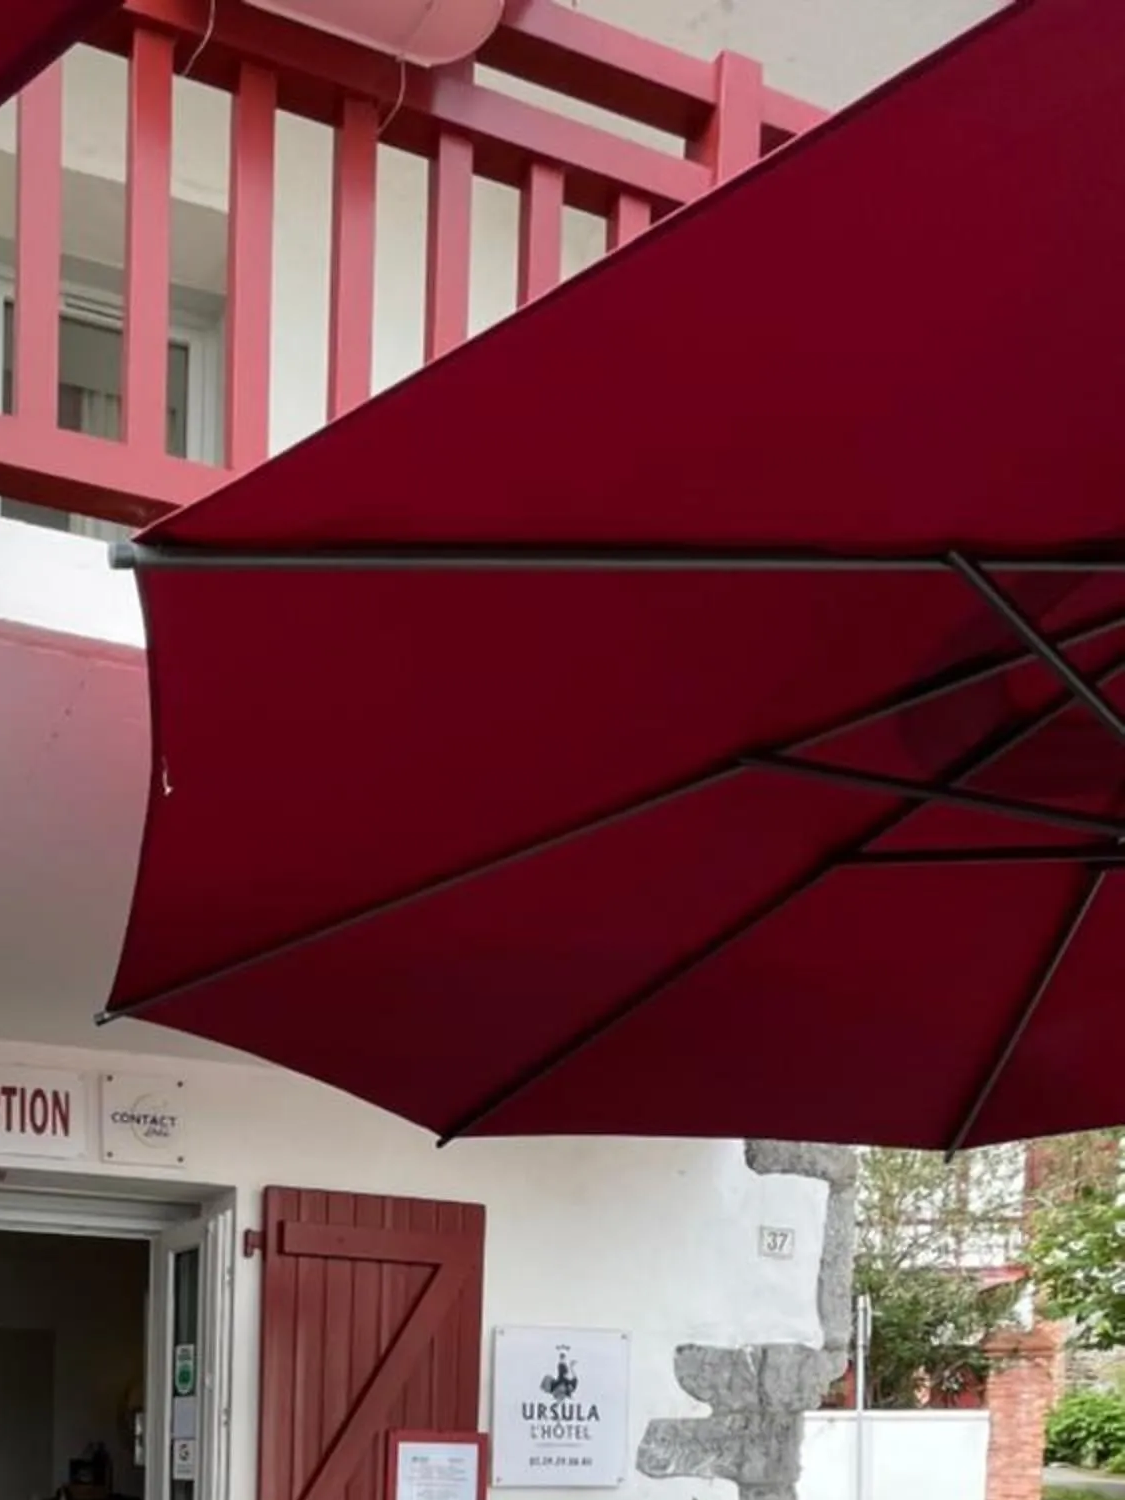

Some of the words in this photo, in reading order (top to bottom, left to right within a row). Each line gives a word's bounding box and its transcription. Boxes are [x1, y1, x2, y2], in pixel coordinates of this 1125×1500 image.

[111, 1111, 177, 1127] CONTACT
[767, 1231, 788, 1251] 37
[522, 1401, 600, 1422] URSULA
[530, 1420, 592, 1440] L'HÔTEL
